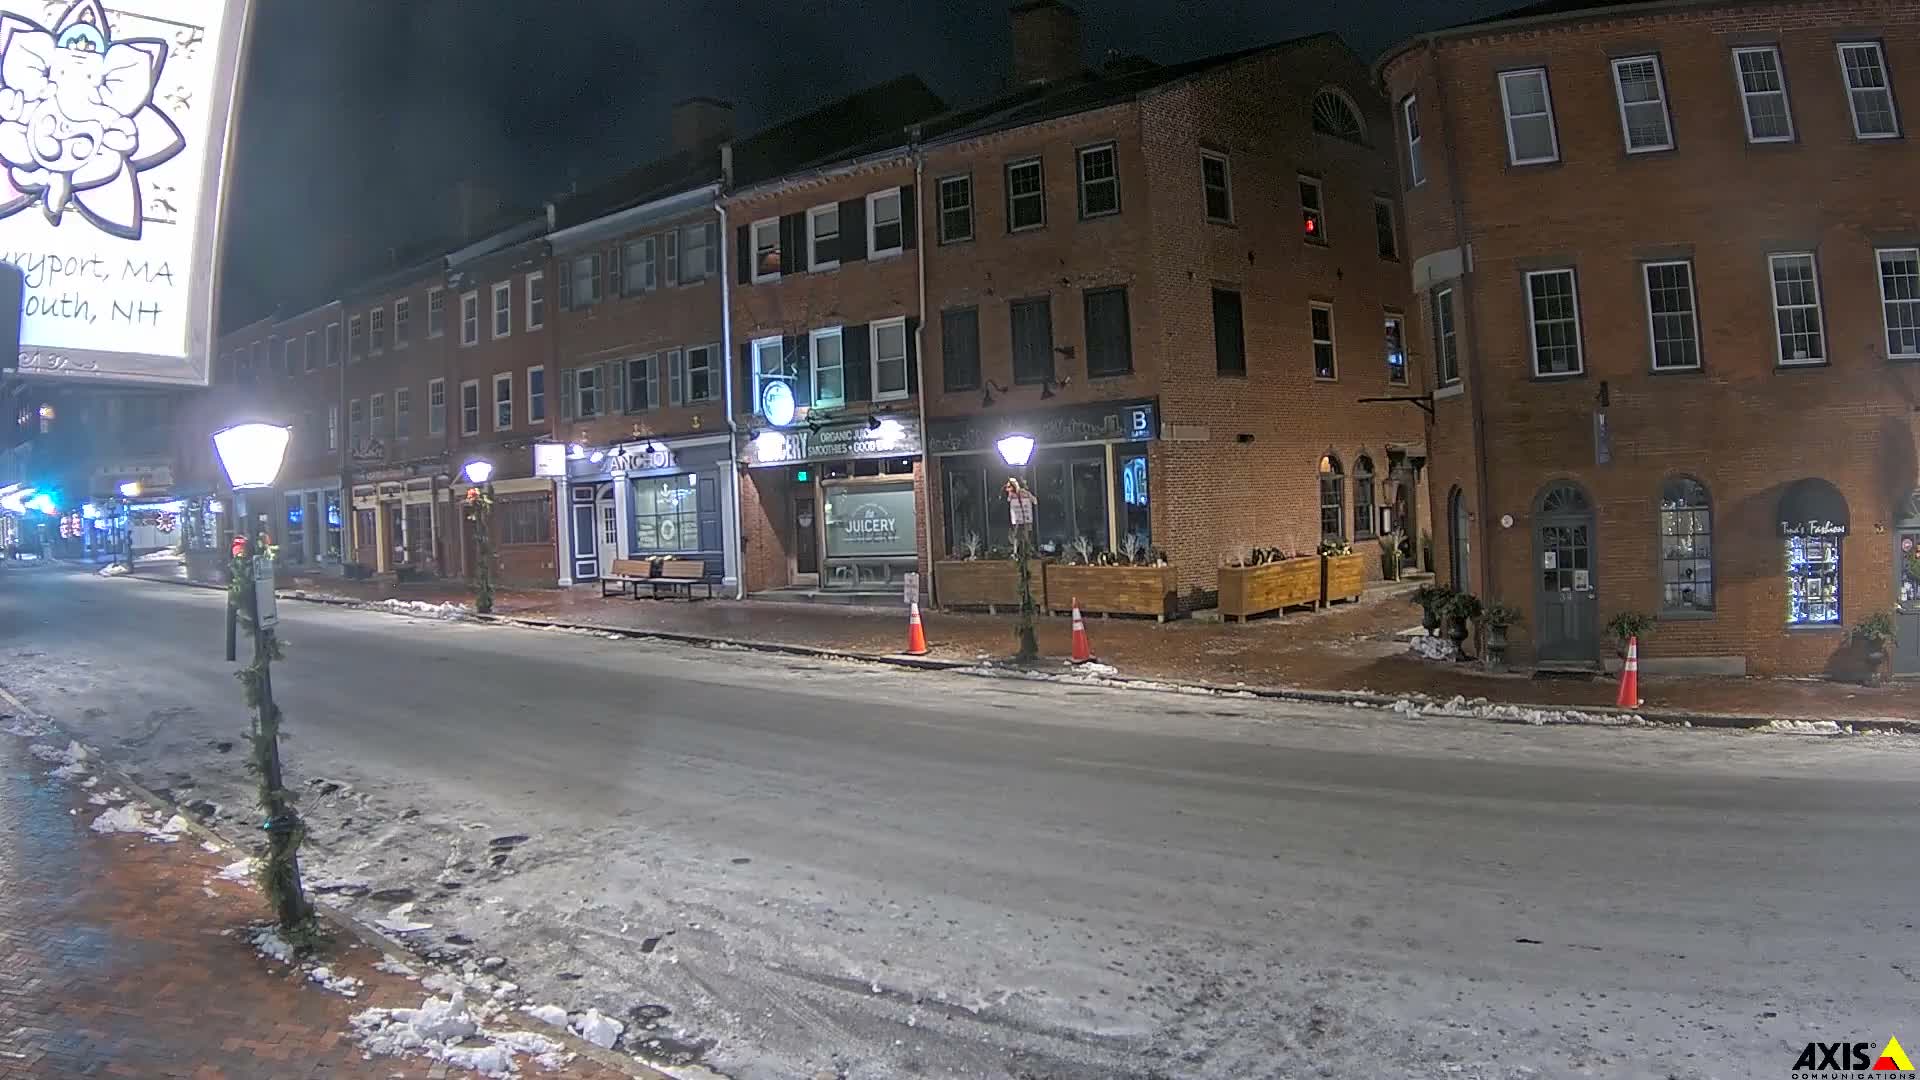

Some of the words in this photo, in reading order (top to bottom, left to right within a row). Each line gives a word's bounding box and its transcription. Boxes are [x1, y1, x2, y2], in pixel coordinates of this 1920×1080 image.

[122, 259, 174, 287] MA
[112, 299, 163, 326] NH
[819, 431, 853, 443] ORGANIC
[808, 443, 848, 457] SMOOTHIES
[853, 440, 877, 453] GOOD
[845, 518, 896, 533] JUICERY
